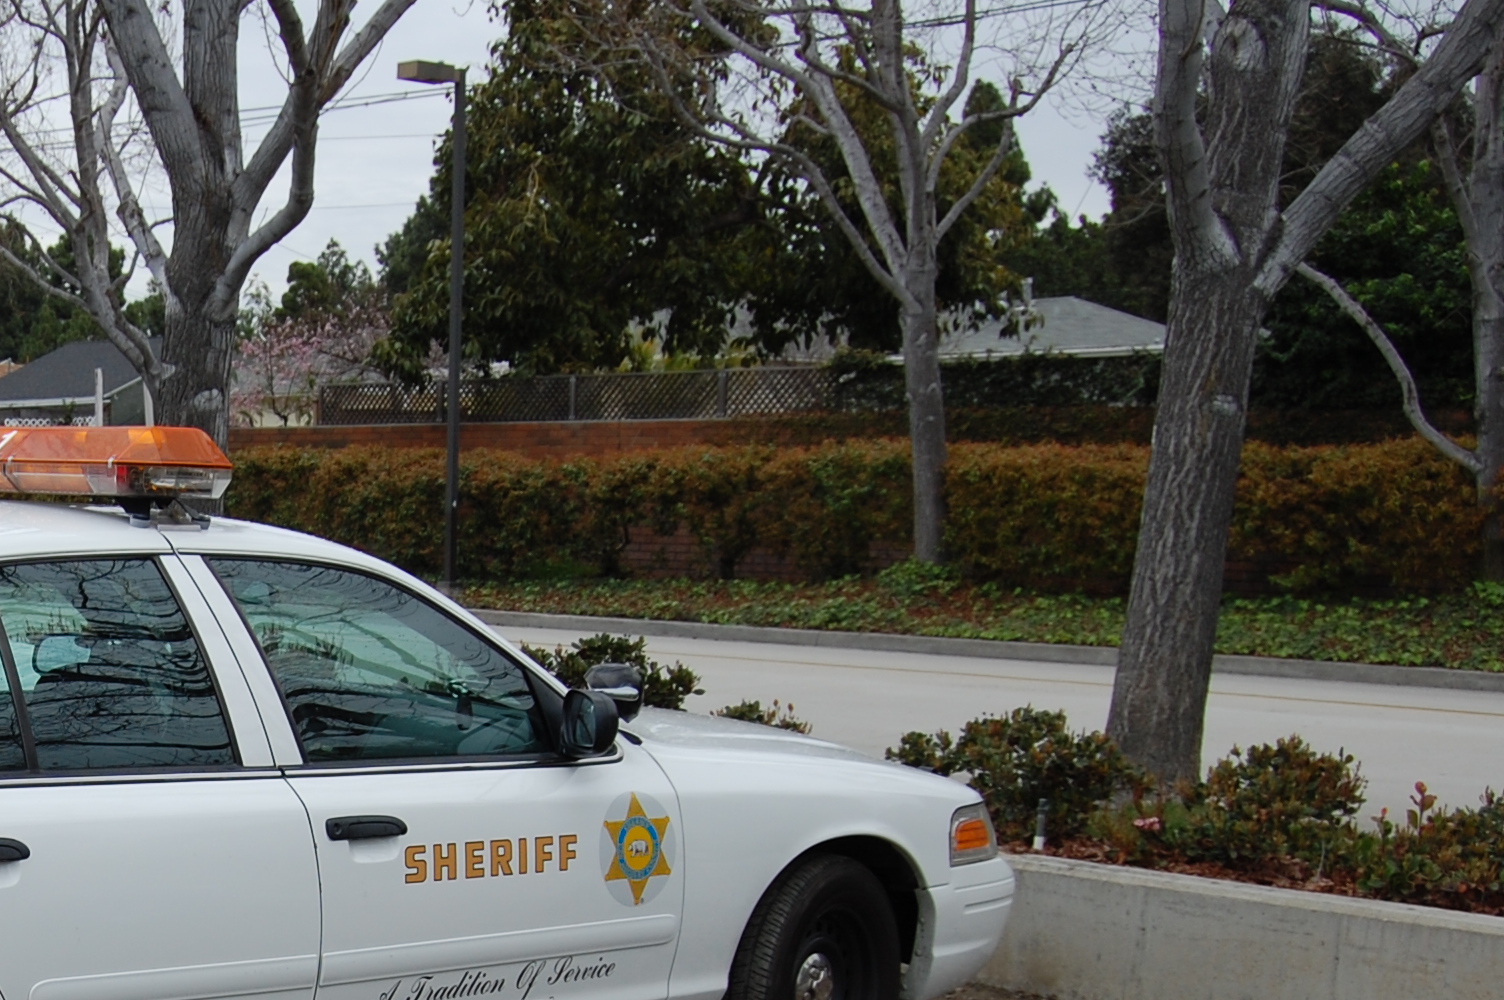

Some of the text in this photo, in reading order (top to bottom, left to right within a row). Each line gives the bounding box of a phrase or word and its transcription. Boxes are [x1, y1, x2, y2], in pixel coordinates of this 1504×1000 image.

[404, 834, 578, 884] SHERIFF
[516, 960, 546, 1000] Of
[547, 955, 617, 986] Service
